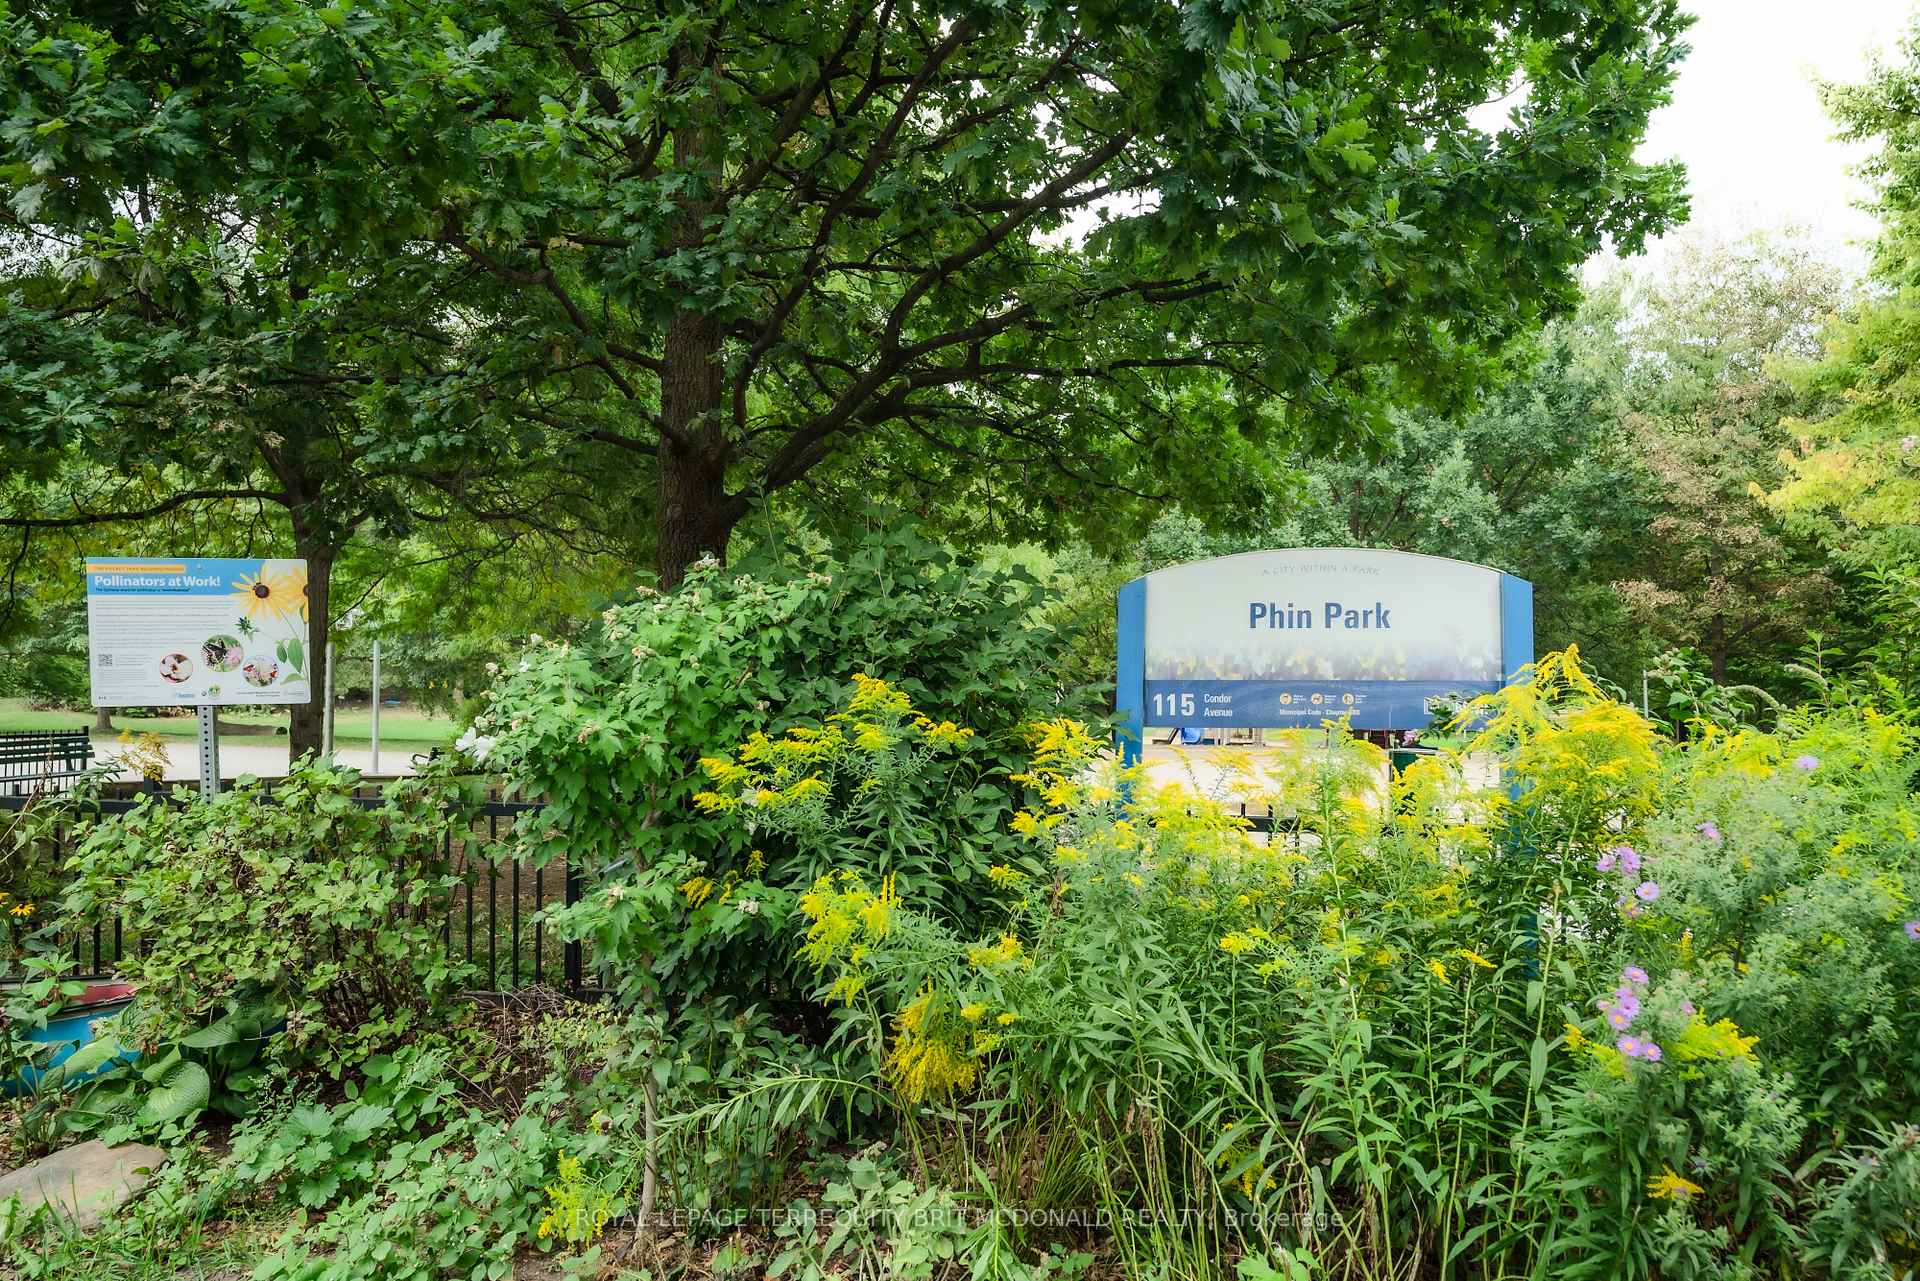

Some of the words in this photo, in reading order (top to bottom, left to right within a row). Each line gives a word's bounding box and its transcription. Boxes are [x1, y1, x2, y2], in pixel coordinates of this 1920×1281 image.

[94, 575, 165, 587] Pollinators
[168, 577, 181, 587] at
[182, 575, 221, 587] Work!
[1249, 602, 1312, 629] Phin
[1324, 602, 1391, 629] Park
[1204, 694, 1232, 703] Condor
[1153, 693, 1195, 717] 115
[1204, 707, 1233, 717] Avenue
